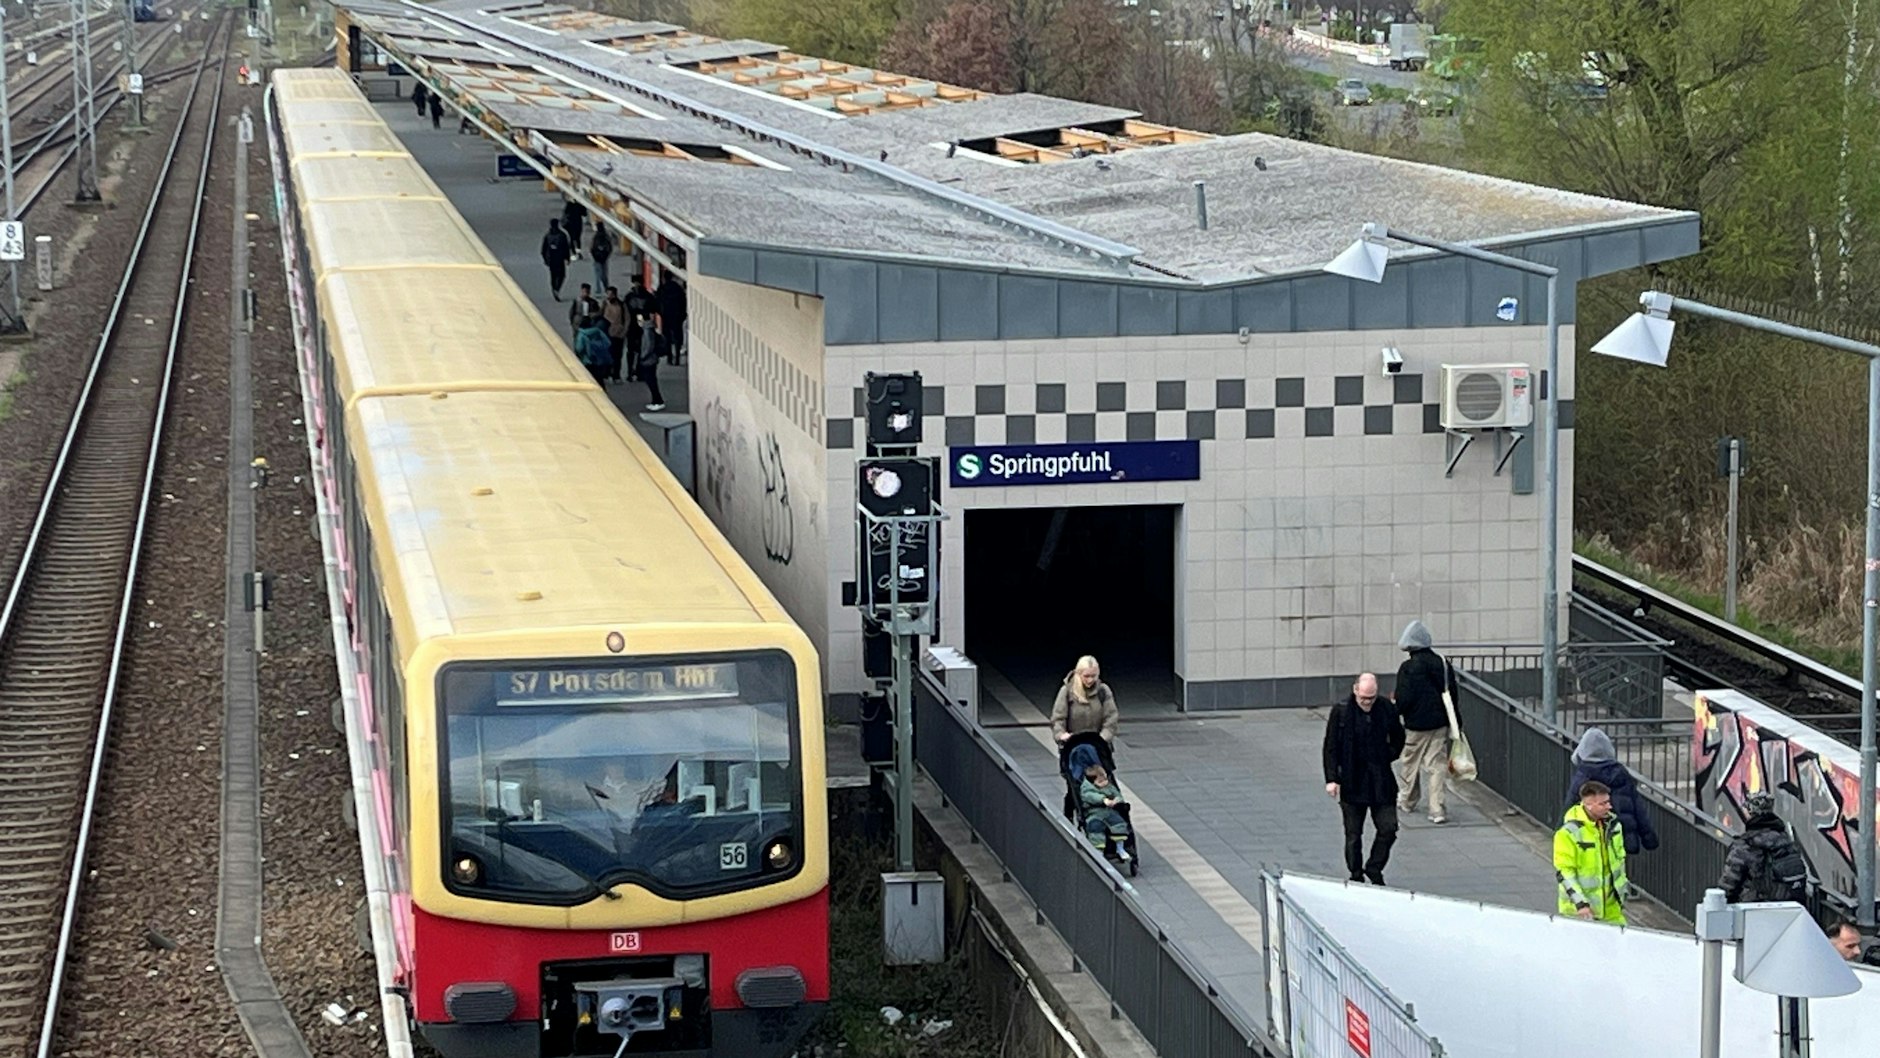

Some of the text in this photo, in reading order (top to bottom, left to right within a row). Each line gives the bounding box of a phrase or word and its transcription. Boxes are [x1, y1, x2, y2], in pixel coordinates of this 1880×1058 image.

[6, 224, 16, 238] 8
[959, 451, 1111, 478] S Springpfuhl
[511, 671, 539, 694] S7
[722, 846, 745, 865] 56
[614, 934, 637, 949] DB
